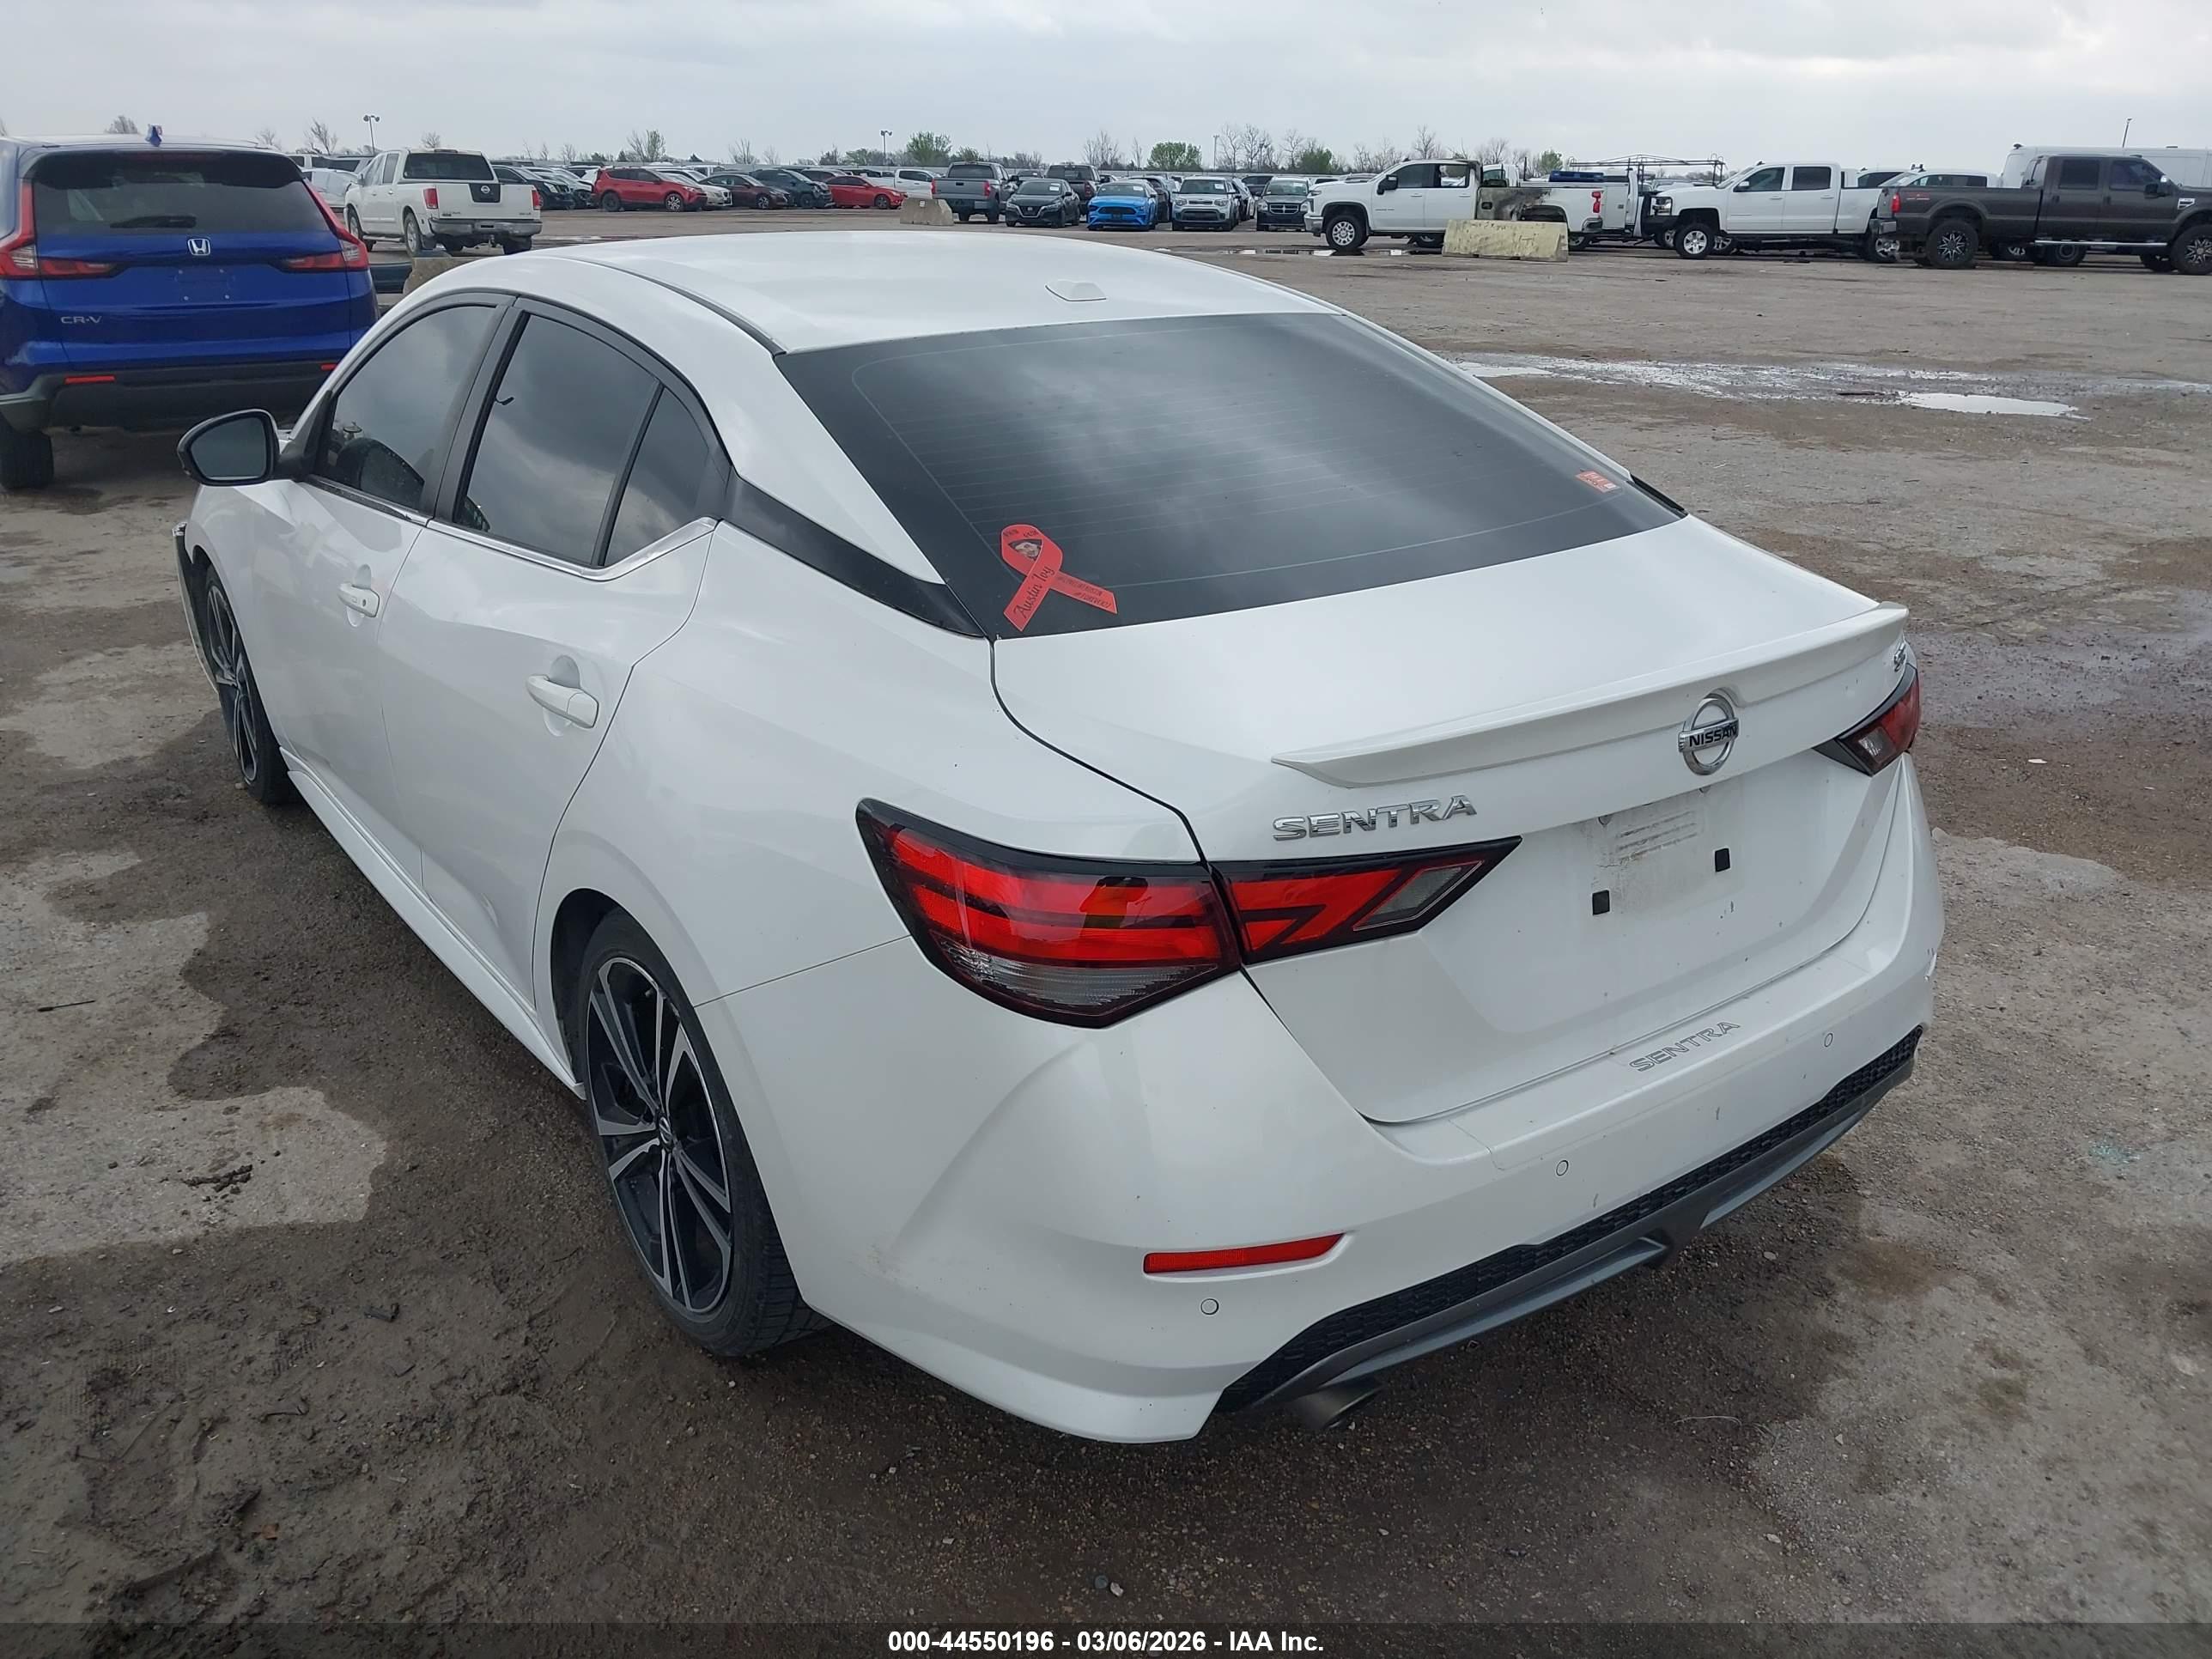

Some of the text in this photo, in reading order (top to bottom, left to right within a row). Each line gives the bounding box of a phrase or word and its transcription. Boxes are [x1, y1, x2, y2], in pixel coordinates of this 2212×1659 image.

[1013, 584, 1042, 619] Austin
[1689, 721, 1739, 747] NISSAN
[1273, 794, 1478, 842] SENTRA
[1629, 1021, 1741, 1072] SENTRA
